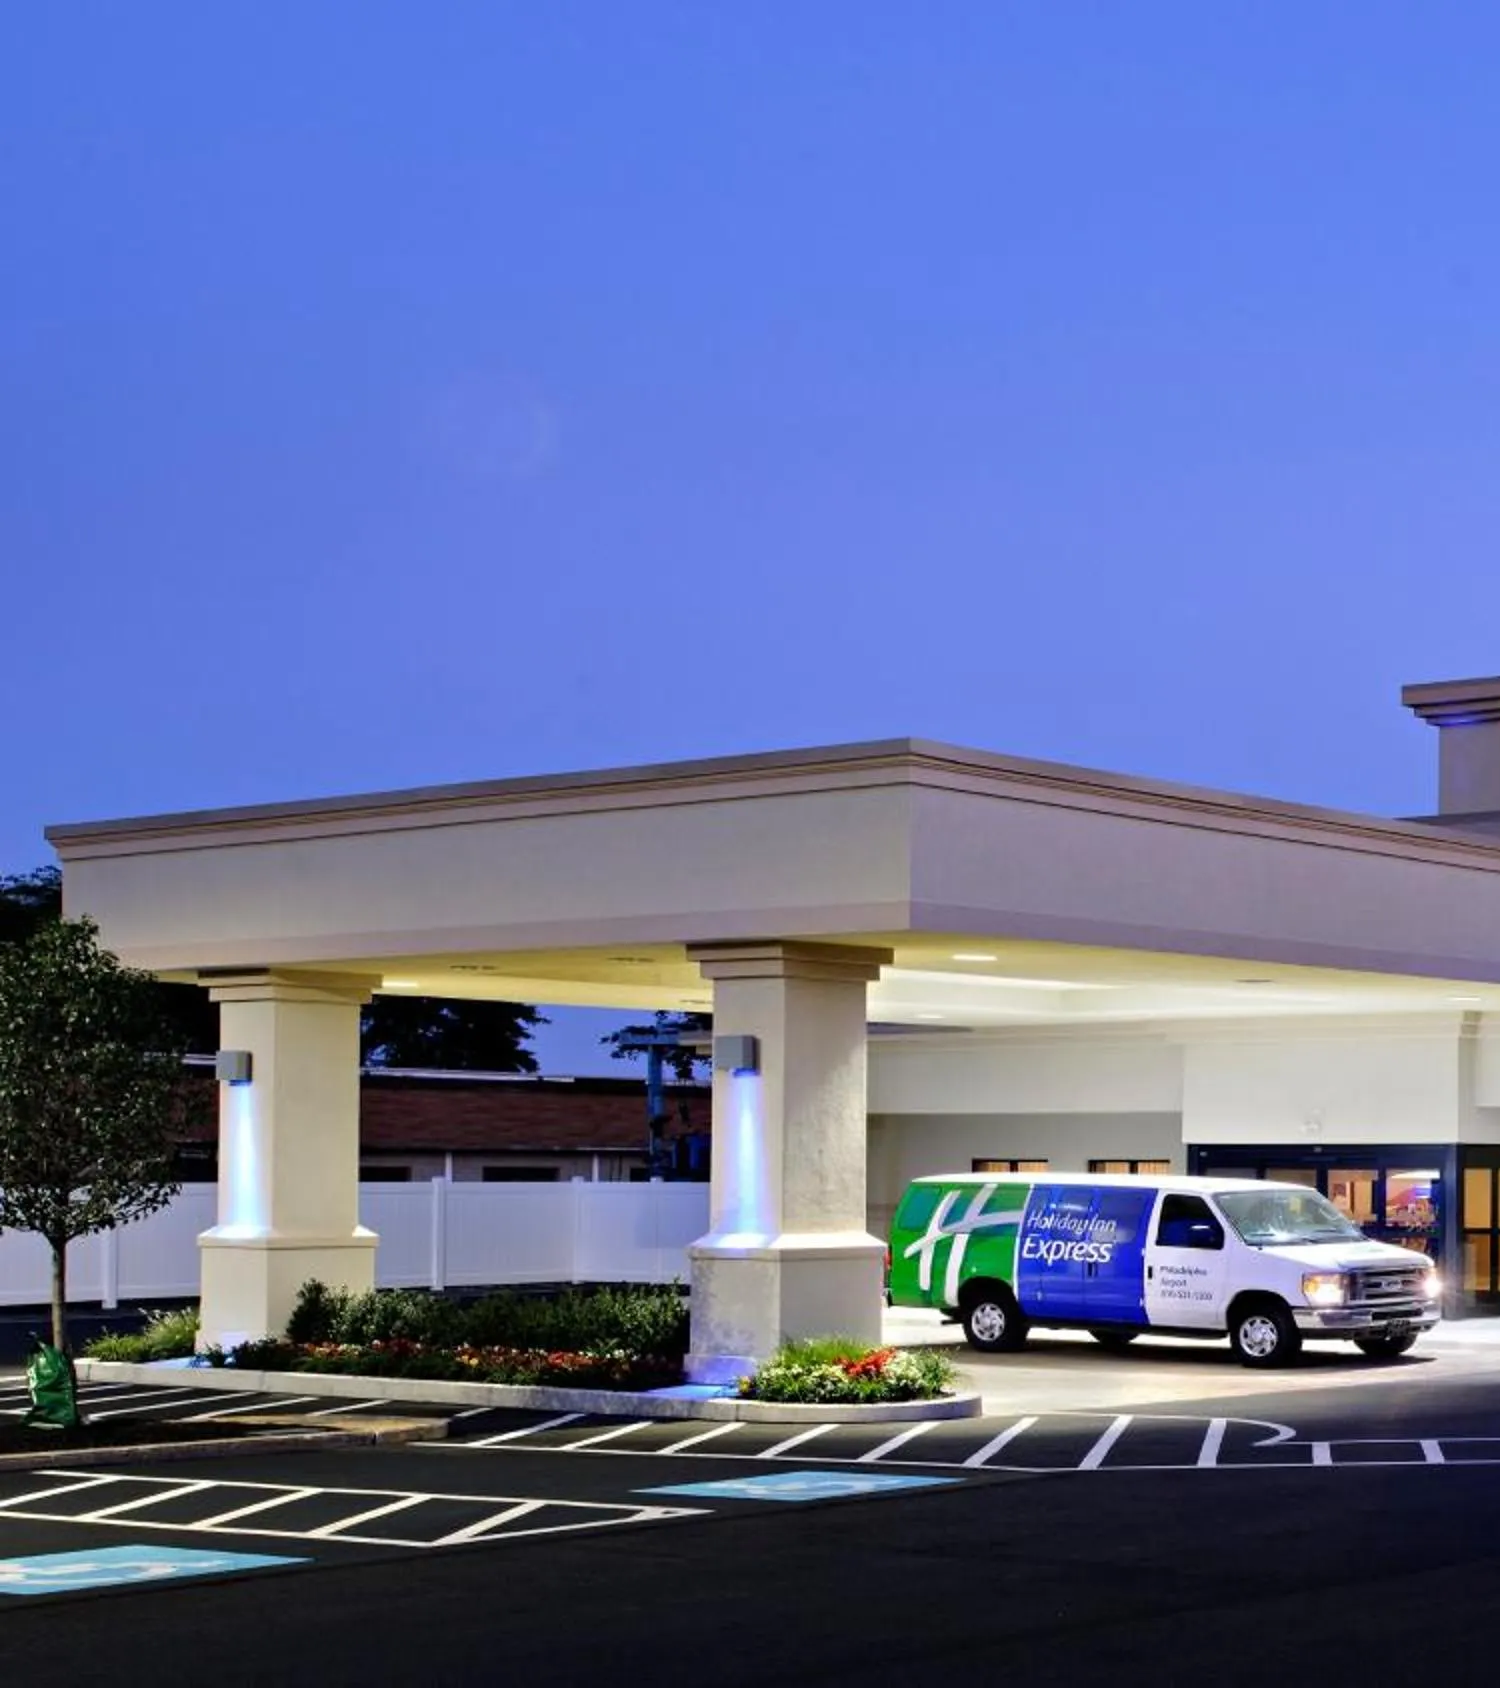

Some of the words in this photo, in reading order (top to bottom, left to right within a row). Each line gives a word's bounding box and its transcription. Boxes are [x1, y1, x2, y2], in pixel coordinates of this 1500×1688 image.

[1027, 1211, 1089, 1235] Holiday
[1088, 1213, 1117, 1233] Inn
[1021, 1233, 1113, 1267] Express
